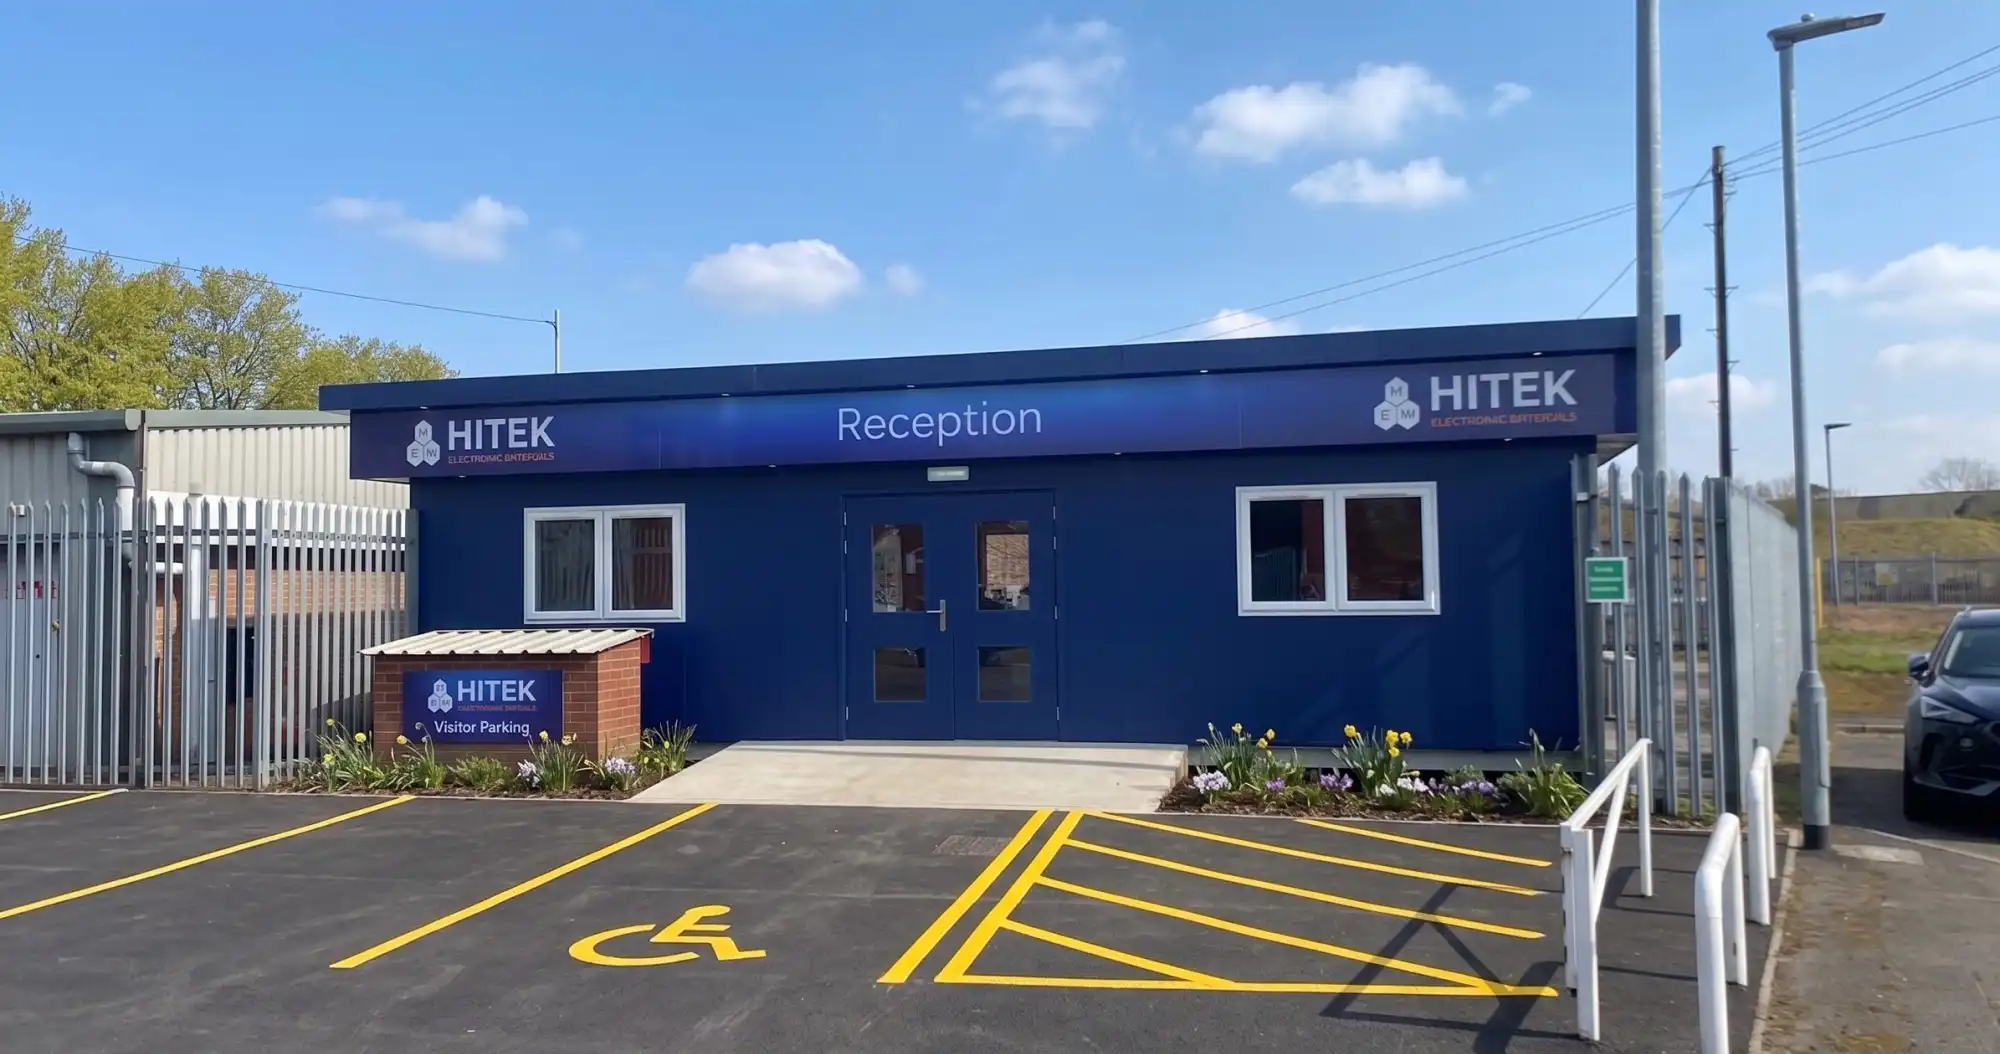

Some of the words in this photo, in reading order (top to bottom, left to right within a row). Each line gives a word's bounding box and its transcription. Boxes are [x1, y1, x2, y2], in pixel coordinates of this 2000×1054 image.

[1390, 385, 1402, 397] M
[1430, 369, 1578, 411] HITEK
[419, 427, 428, 437] M
[838, 400, 1042, 447] Reception
[448, 416, 555, 450] HITEK
[411, 448, 419, 458] E
[457, 680, 537, 701] HITEK
[434, 720, 476, 733] Visitor
[480, 720, 530, 736] Parking
